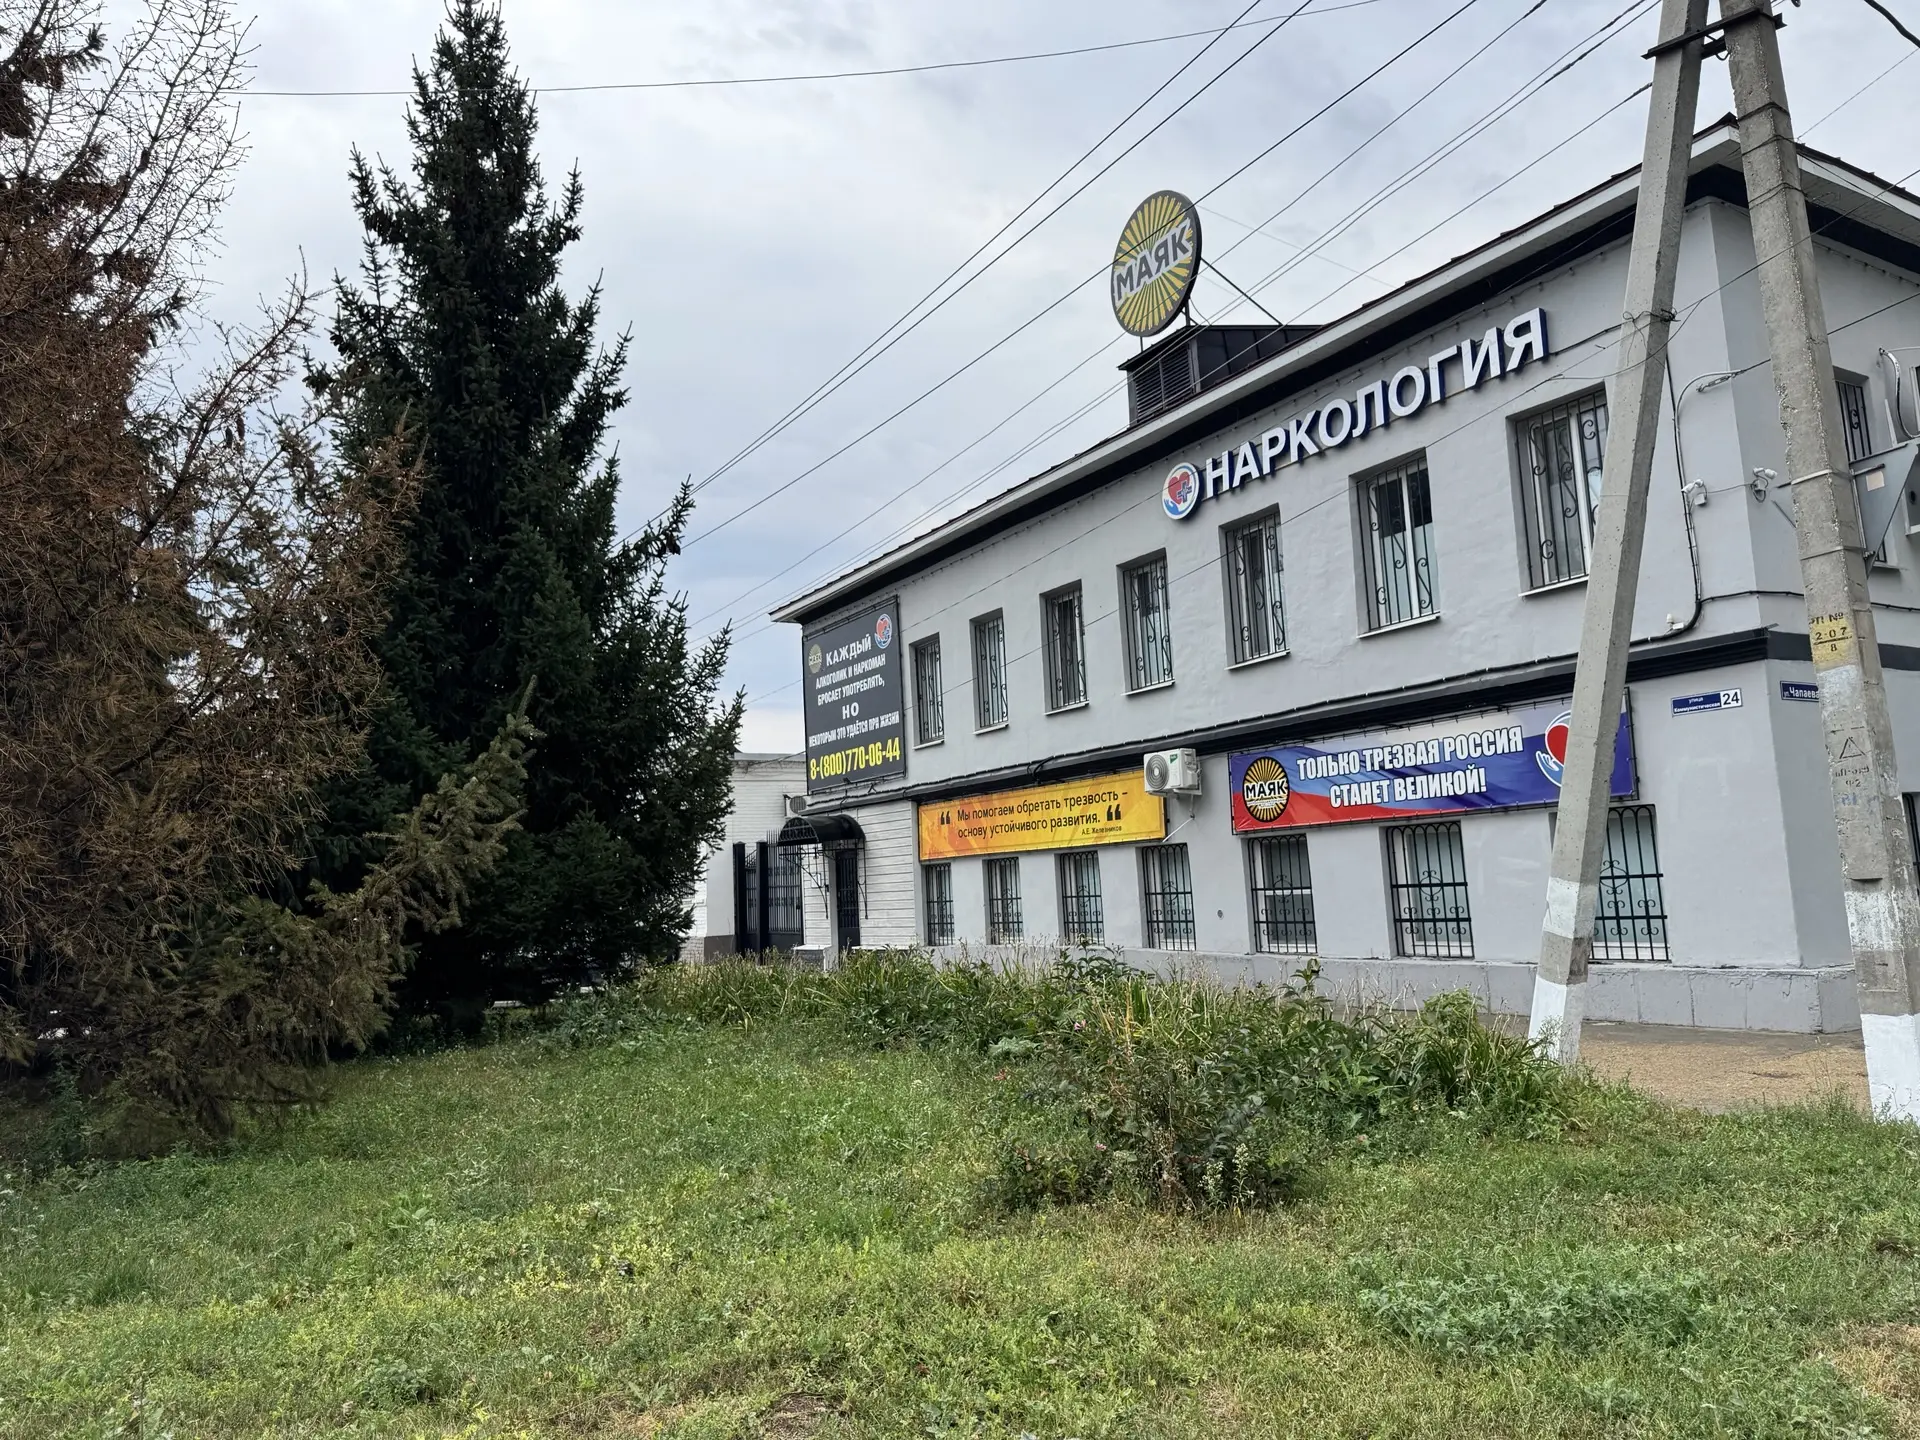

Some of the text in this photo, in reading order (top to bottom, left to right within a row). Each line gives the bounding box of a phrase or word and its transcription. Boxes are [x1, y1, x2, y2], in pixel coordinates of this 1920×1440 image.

[1116, 225, 1189, 302] МАЯК
[1205, 307, 1549, 499] НАРКОЛОГИЯ
[826, 633, 872, 667] КАЖДЫЙ
[1830, 643, 1838, 652] 8
[815, 653, 886, 690] АЛКОГОЛИК И НАРКОМАН
[817, 673, 885, 707] БРОСАЕТ УПОТРЕБЛЯТЬ,
[1722, 690, 1740, 706] 24
[1789, 686, 1820, 699] Чапаева
[842, 702, 860, 720] НО
[810, 737, 901, 781] 8-(800)770-06-44
[1297, 725, 1523, 782] ТОЛЬКО ТРЕЗВАЯ РОССИЯ
[1245, 779, 1287, 799] МАЯК
[1330, 763, 1487, 809] СТАНЕТ ВЕЛИКОЙ!
[957, 808, 971, 822] Мы
[972, 803, 1015, 820] помогаем
[1016, 798, 1061, 816] обретать
[1064, 788, 1119, 813] трезвость
[958, 823, 988, 840] основу
[989, 816, 1048, 839] устойчивого
[1050, 812, 1101, 833] развития.
